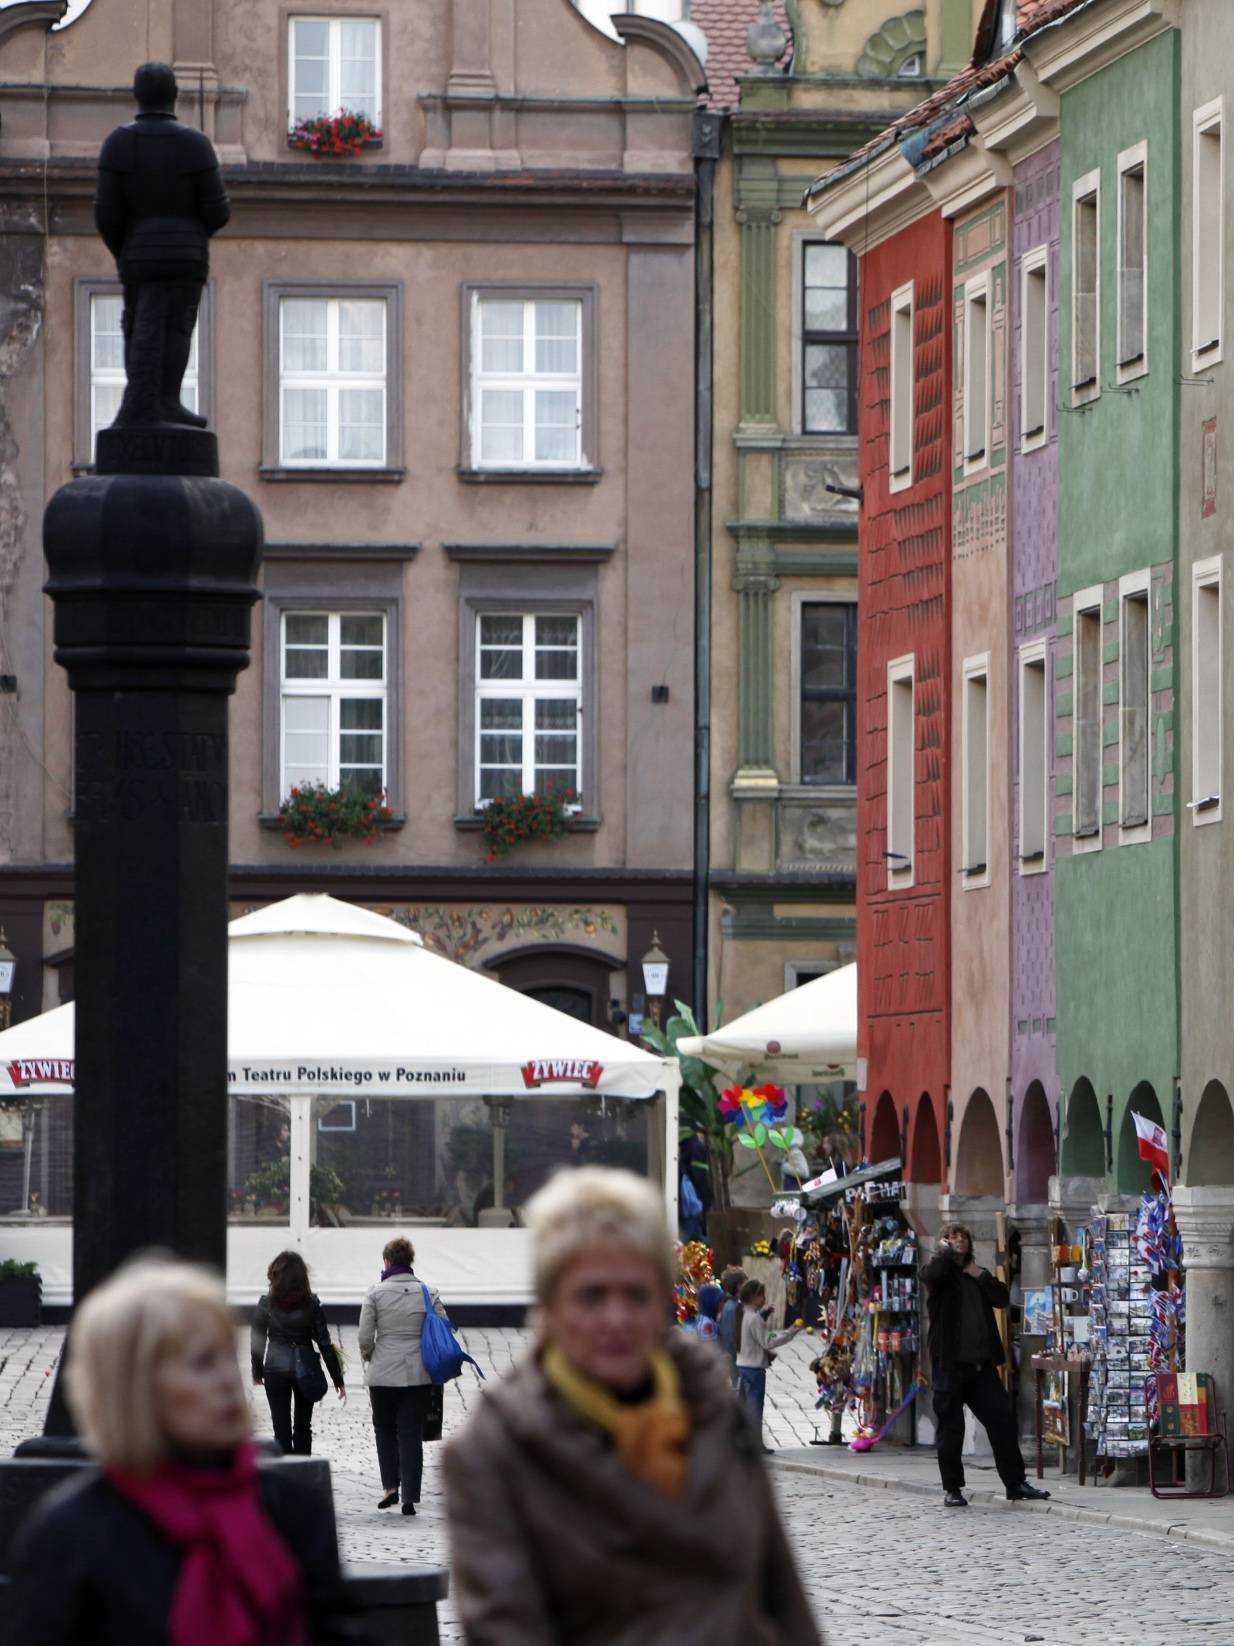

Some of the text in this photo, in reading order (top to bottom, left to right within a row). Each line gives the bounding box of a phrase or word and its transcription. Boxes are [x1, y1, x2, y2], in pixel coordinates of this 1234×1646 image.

[20, 1060, 75, 1080] ŻYWIE
[242, 1067, 291, 1081] Teatru
[297, 1066, 372, 1085] Polskiego
[378, 1071, 390, 1081] w
[396, 1067, 466, 1082] Poznaniu
